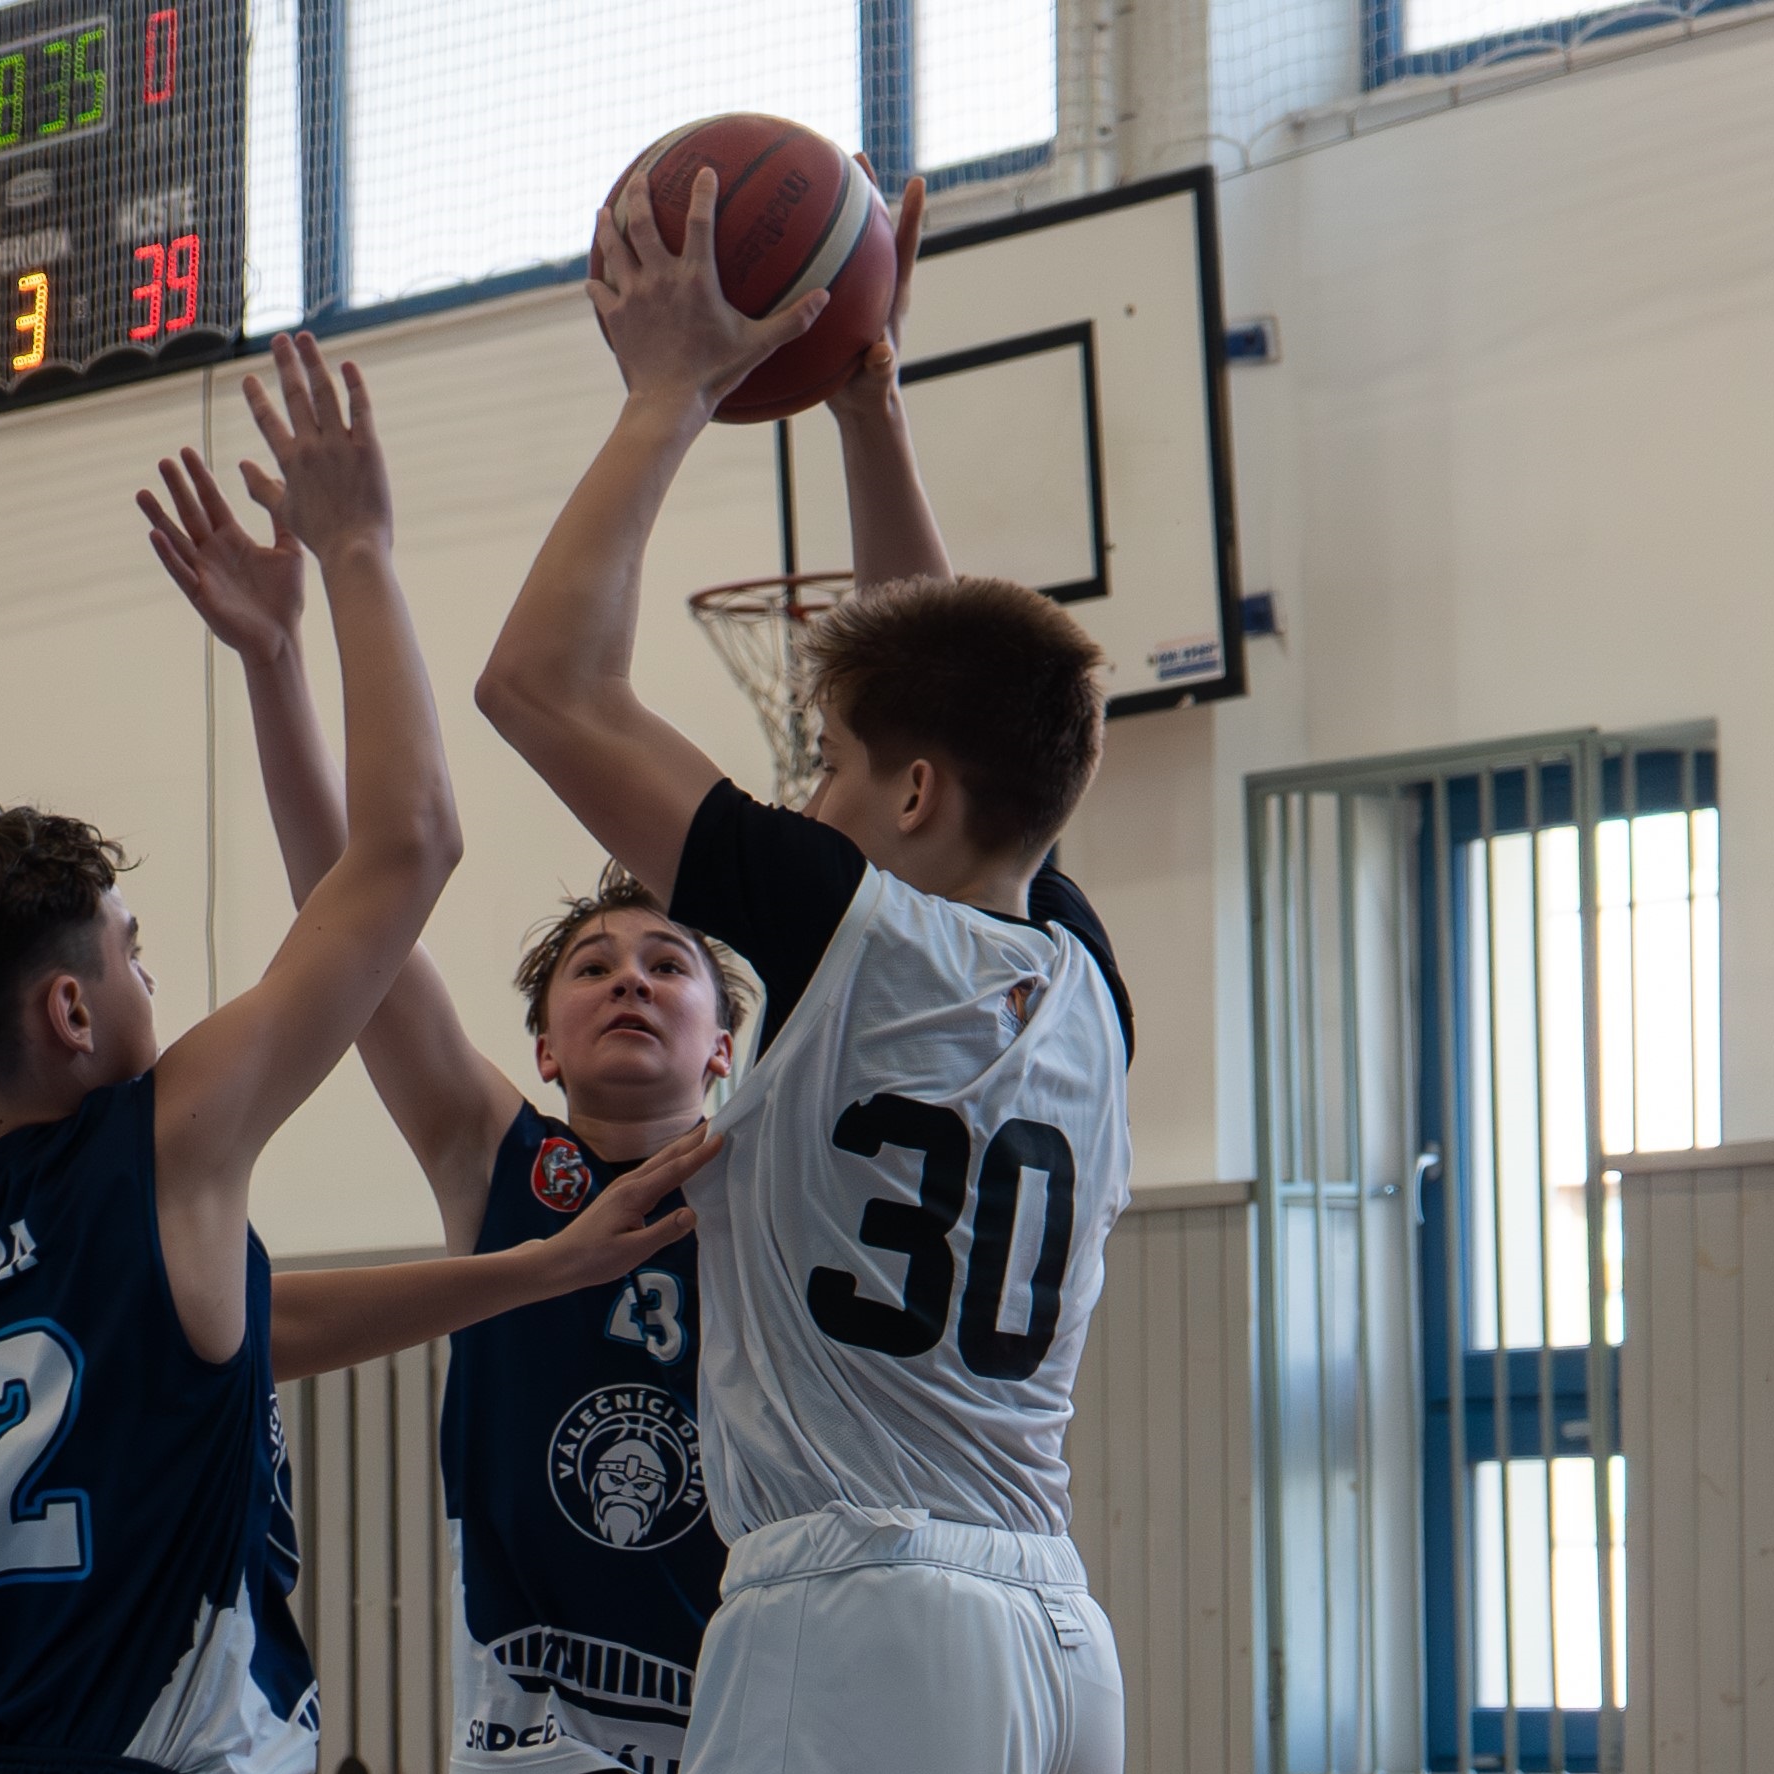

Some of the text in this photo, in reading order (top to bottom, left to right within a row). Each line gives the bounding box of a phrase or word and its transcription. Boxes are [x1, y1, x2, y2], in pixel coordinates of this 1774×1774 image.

[144, 8, 177, 104] 0
[12, 271, 49, 371] 3
[129, 233, 201, 341] 39
[806, 1093, 1076, 1382] 30
[557, 1389, 676, 1480] VÁLEČNÍCI
